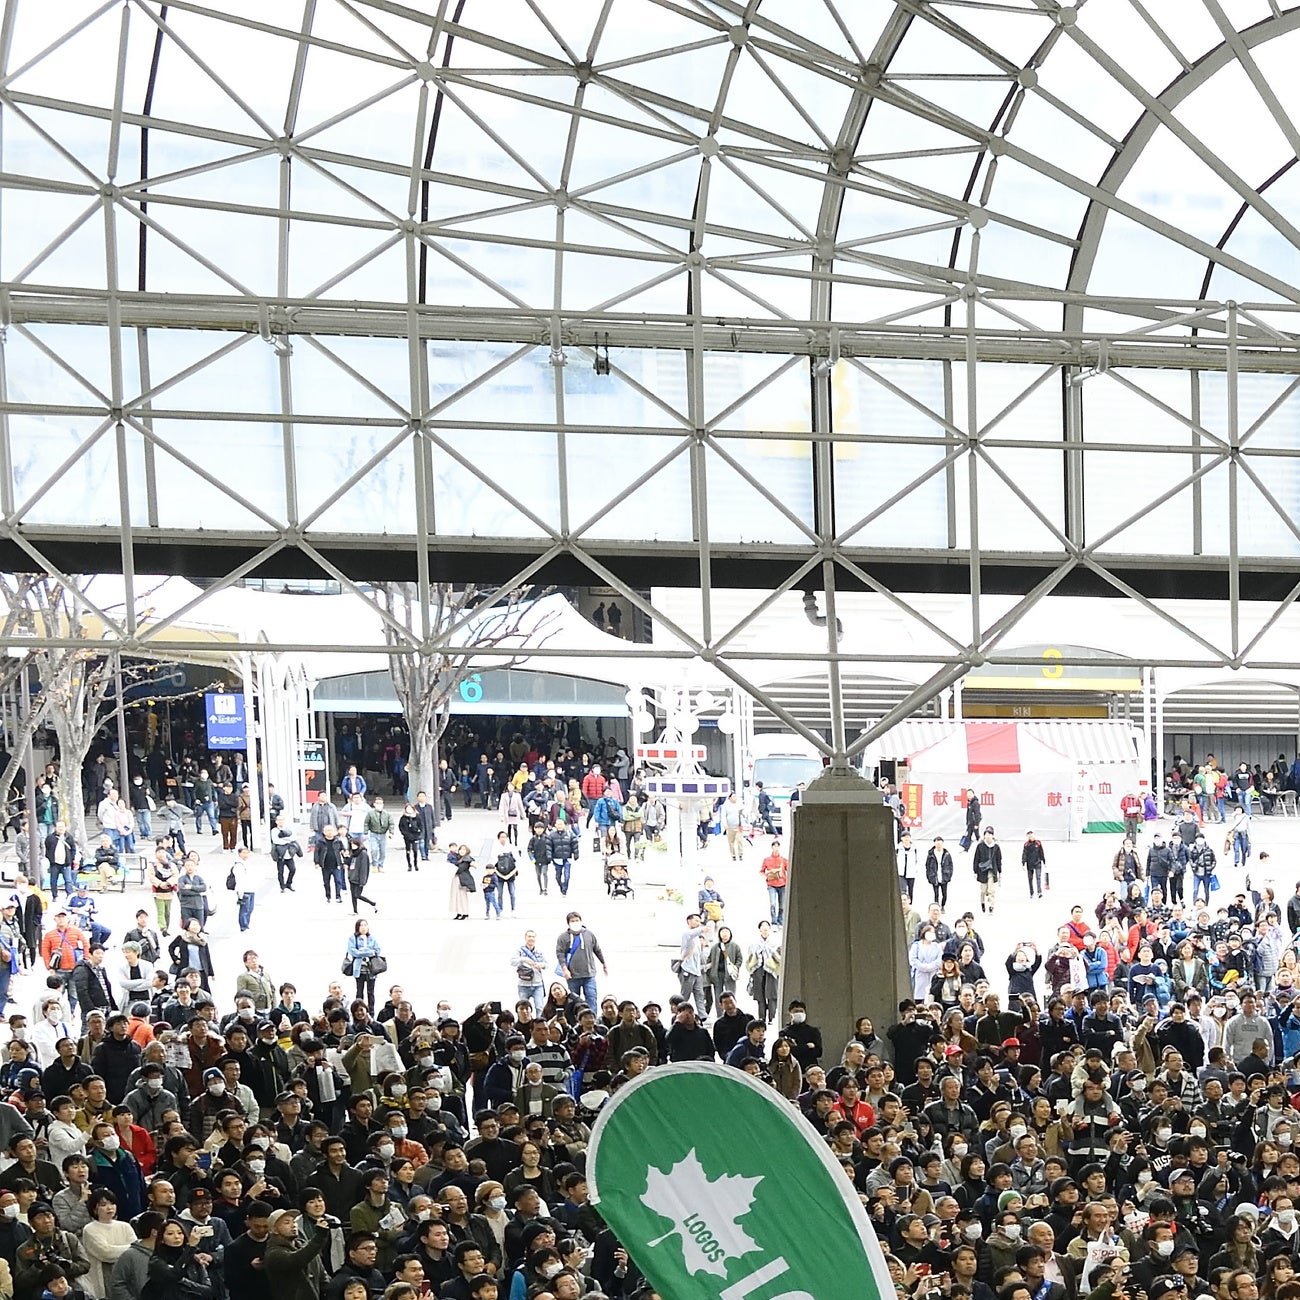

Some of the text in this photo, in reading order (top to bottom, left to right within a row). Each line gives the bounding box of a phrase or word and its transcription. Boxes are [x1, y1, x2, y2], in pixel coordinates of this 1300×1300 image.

[1098, 781, 1112, 795] 血
[932, 791, 995, 806] 献 血
[1047, 792, 1062, 807] 献
[683, 1212, 727, 1263] LOGOS
